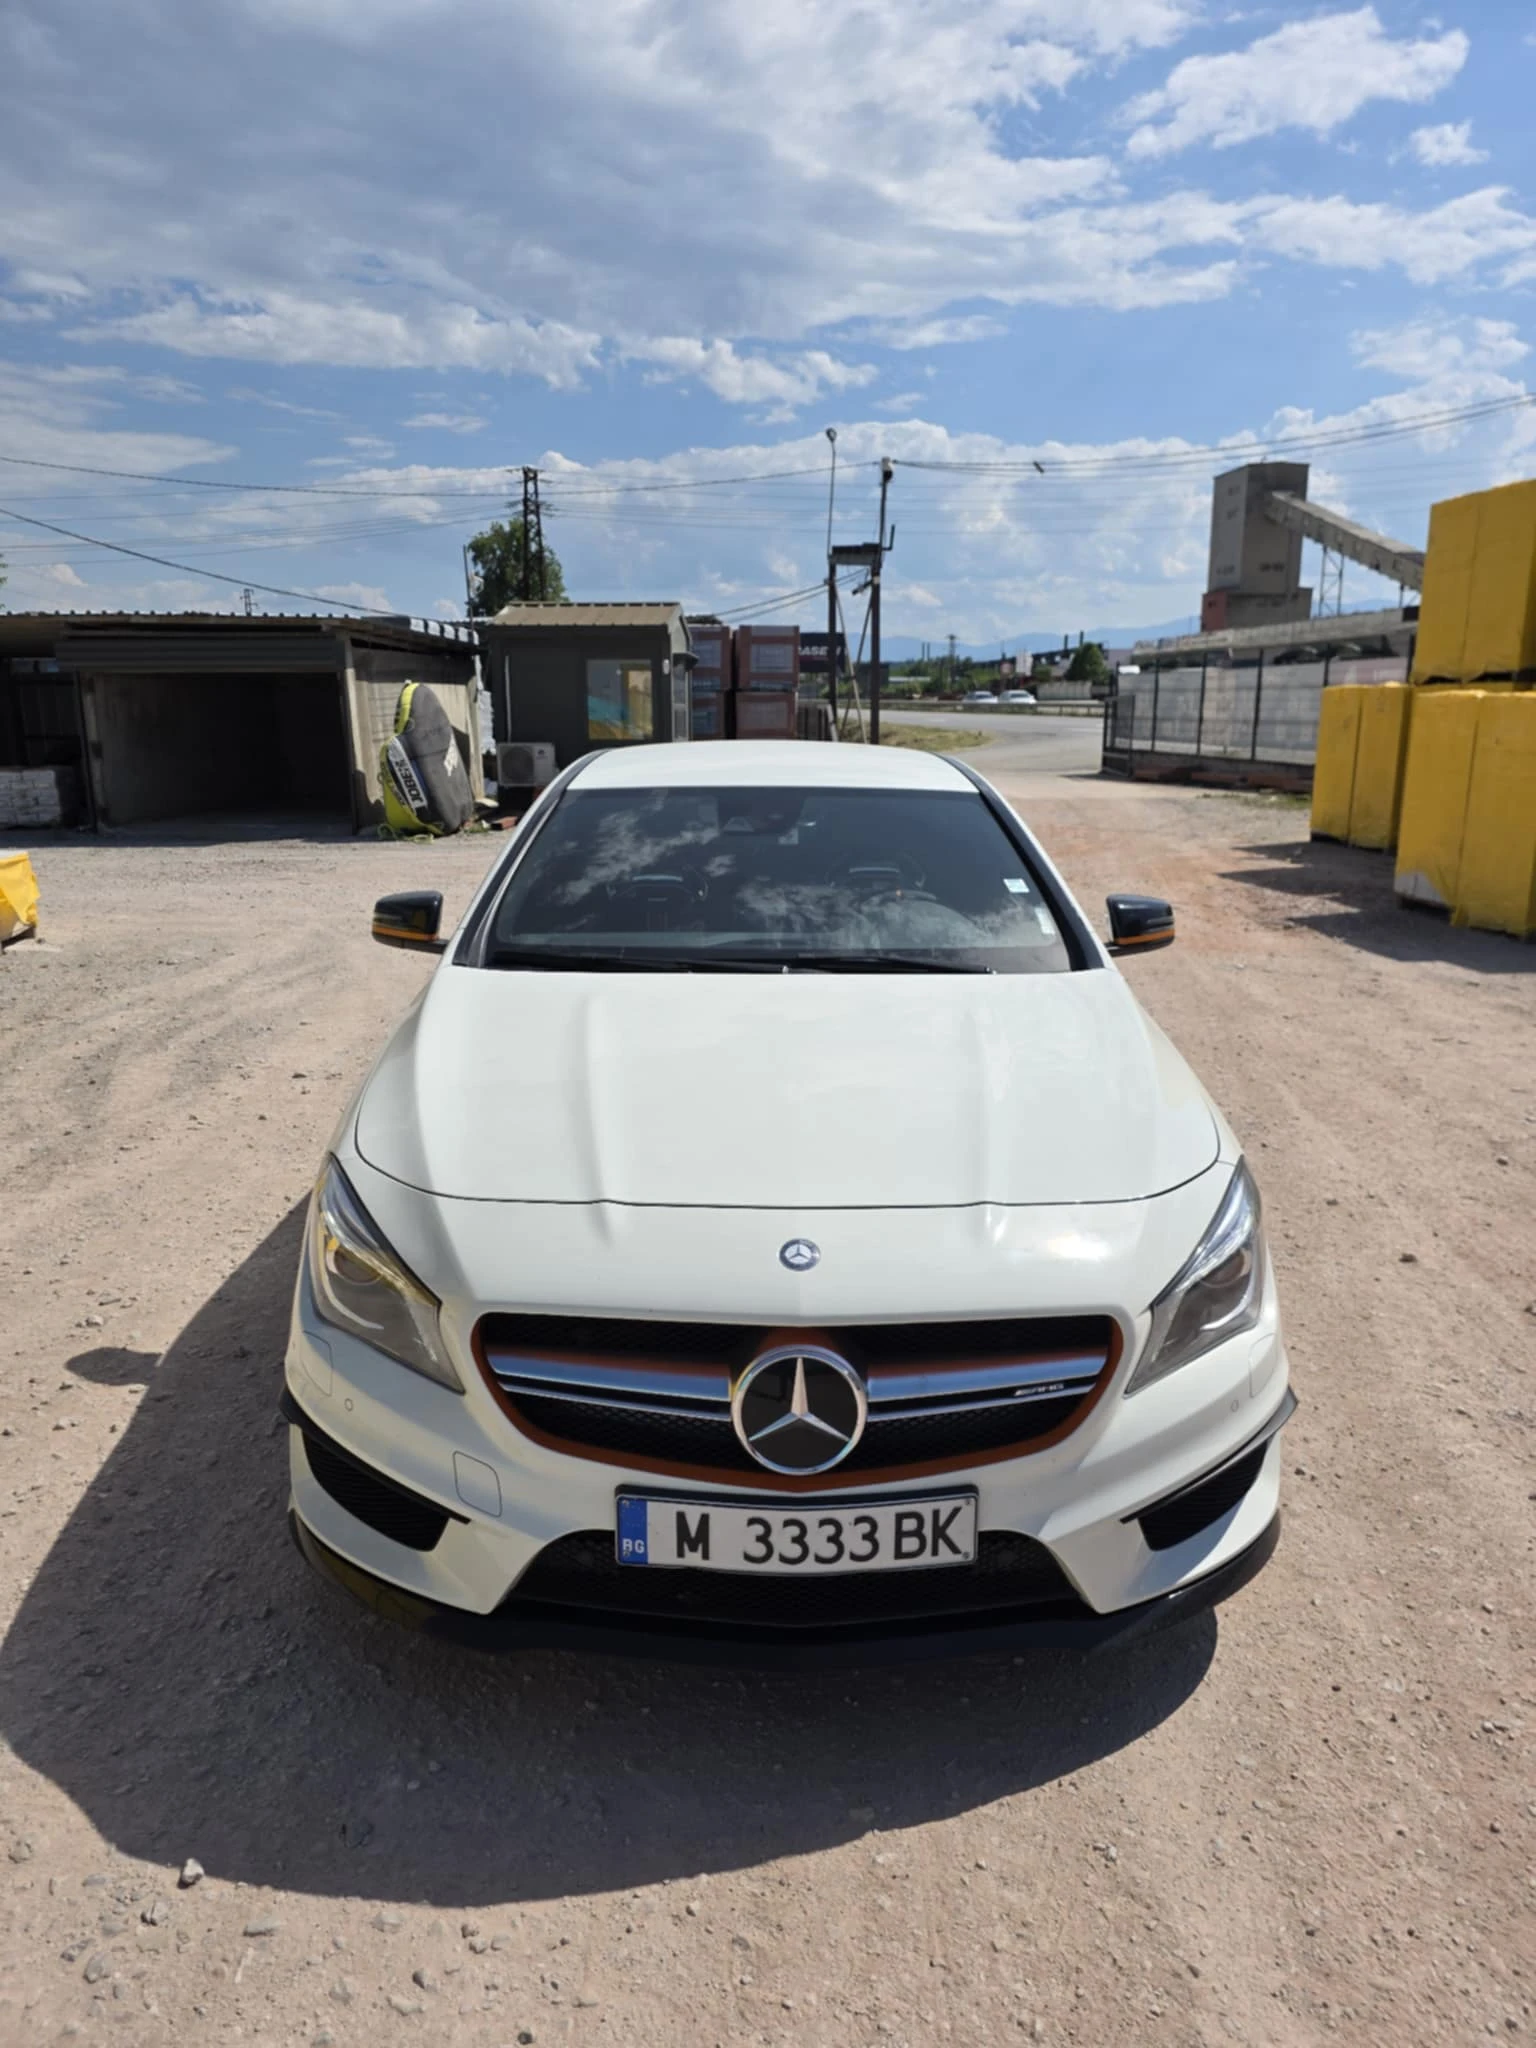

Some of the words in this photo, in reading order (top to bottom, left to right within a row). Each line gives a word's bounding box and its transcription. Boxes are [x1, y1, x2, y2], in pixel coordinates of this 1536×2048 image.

[622, 1538, 645, 1555] BG
[676, 1510, 710, 1561] M
[743, 1515, 880, 1565] 3333
[894, 1506, 963, 1561] BK
